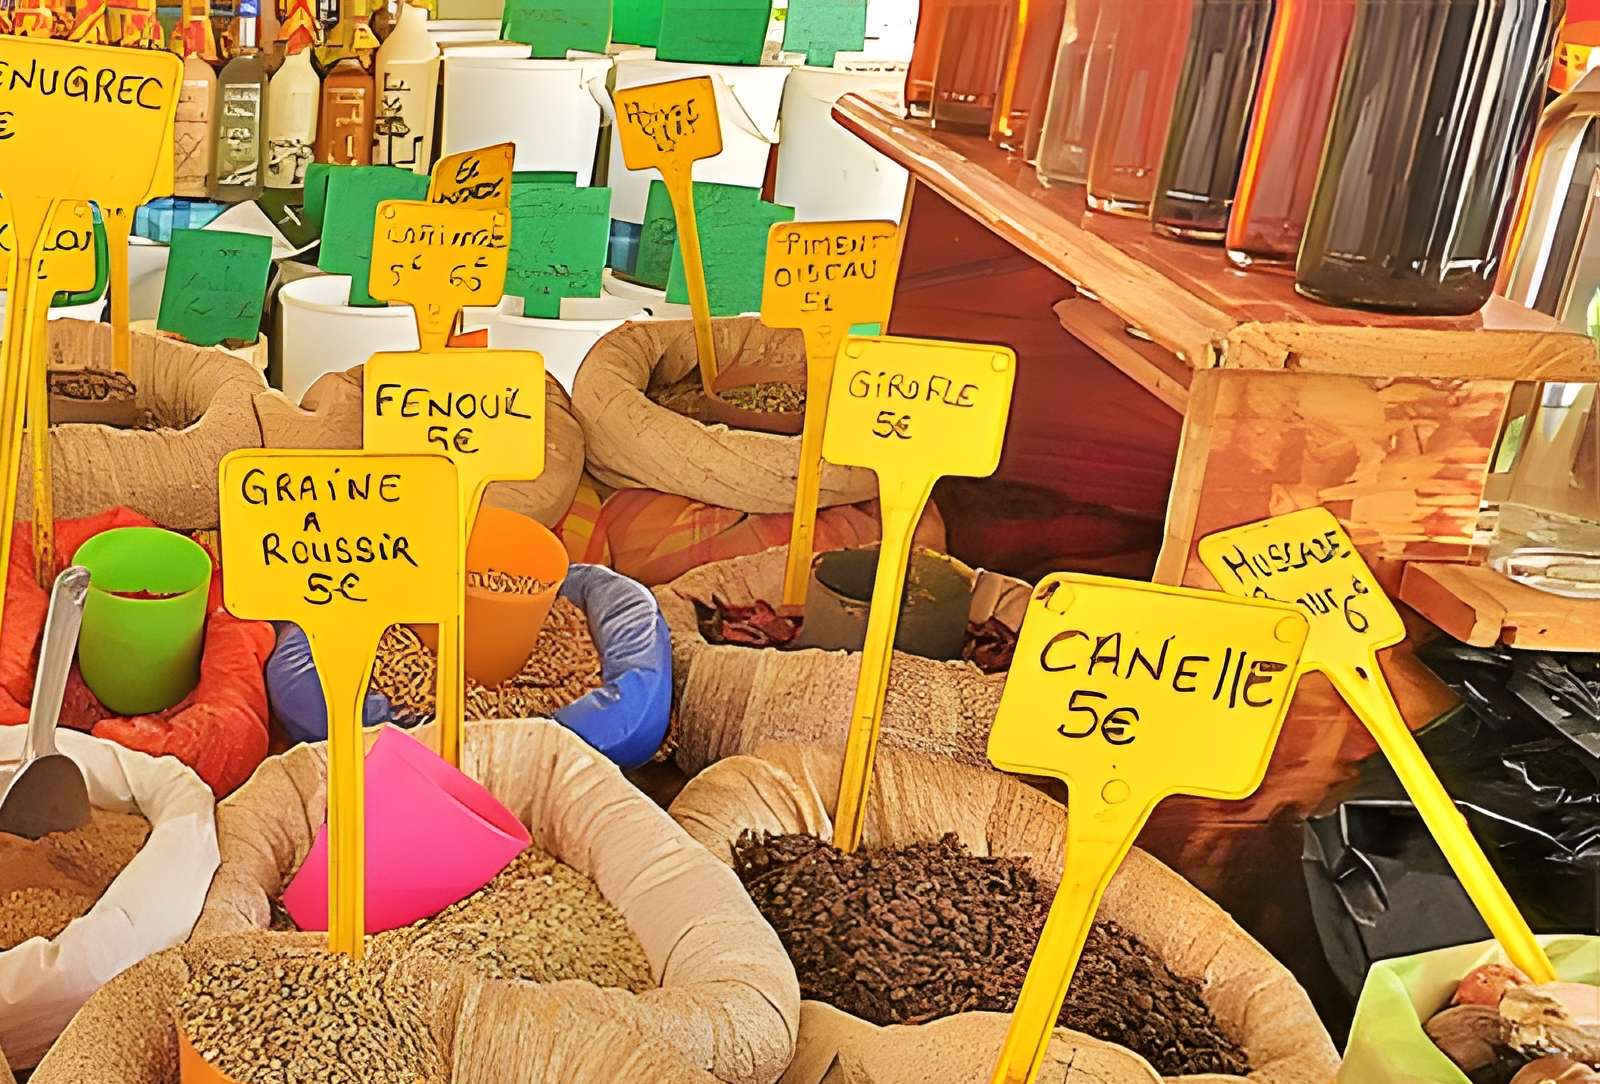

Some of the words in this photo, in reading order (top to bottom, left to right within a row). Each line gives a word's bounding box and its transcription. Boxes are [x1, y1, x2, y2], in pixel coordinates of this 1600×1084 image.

[848, 370, 980, 408] GIROFLE
[241, 467, 402, 506] GRAINE
[303, 511, 321, 533] A
[262, 532, 419, 568] ROUSSIR
[303, 572, 369, 606] 5€
[1057, 689, 1141, 746] 5€
